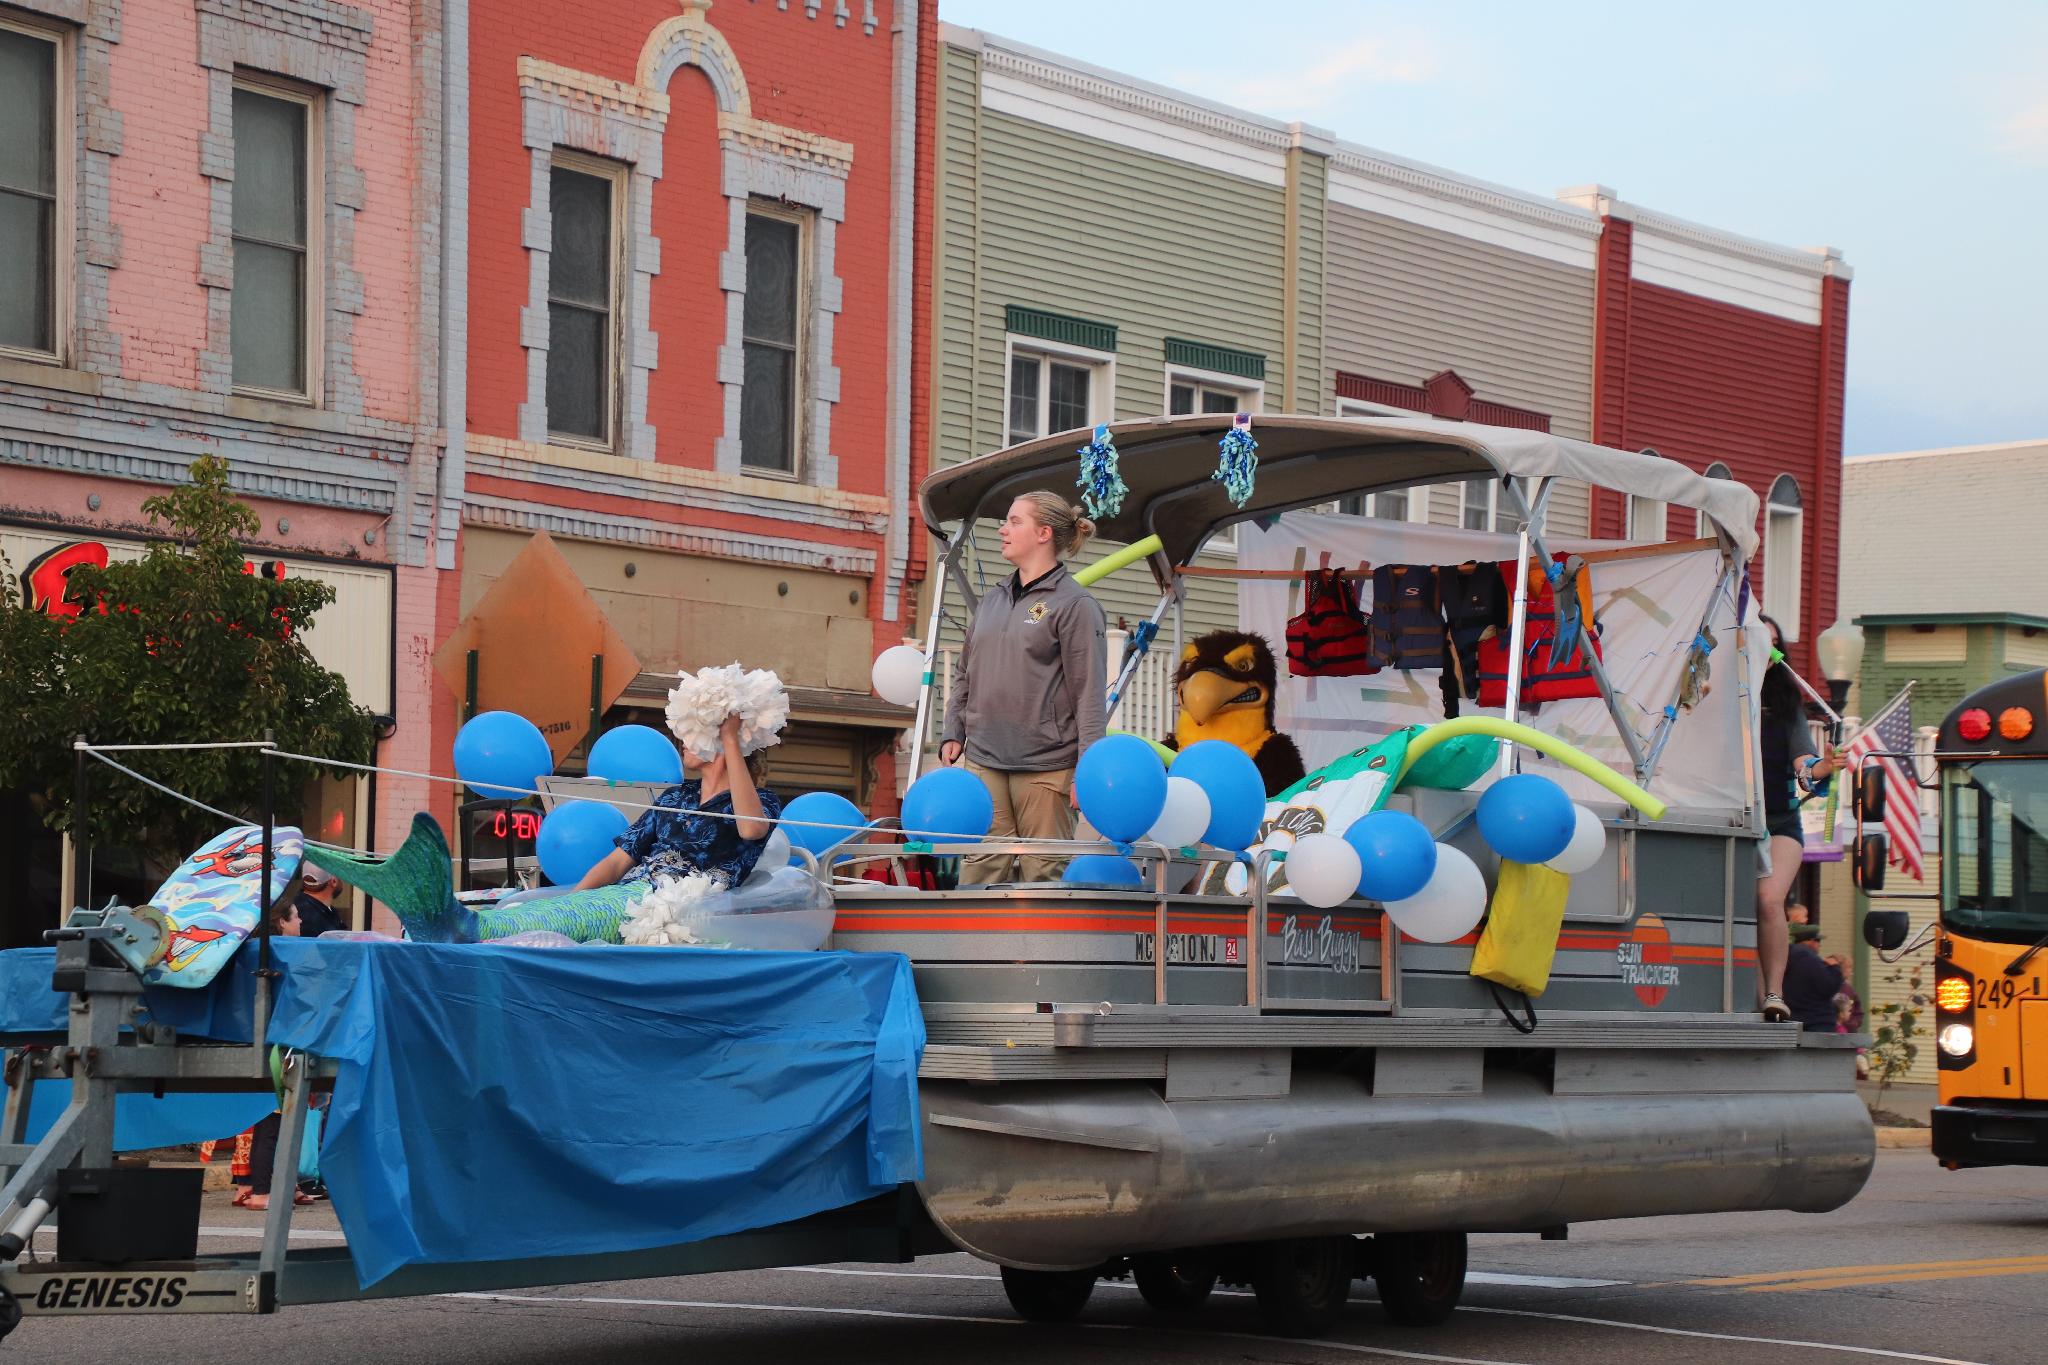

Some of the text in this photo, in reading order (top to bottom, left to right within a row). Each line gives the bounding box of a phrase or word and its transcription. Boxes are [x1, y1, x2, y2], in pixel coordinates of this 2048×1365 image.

[495, 811, 542, 839] OPEN
[1135, 933, 1153, 961] MC
[1200, 935, 1217, 962] NJ
[1227, 942, 1236, 956] 24
[1317, 914, 1361, 974] Buggy
[1617, 942, 1643, 963] SUN
[1621, 964, 1680, 986] TRACKER
[1977, 978, 2015, 1010] 249
[36, 1277, 188, 1309] GENESIS
